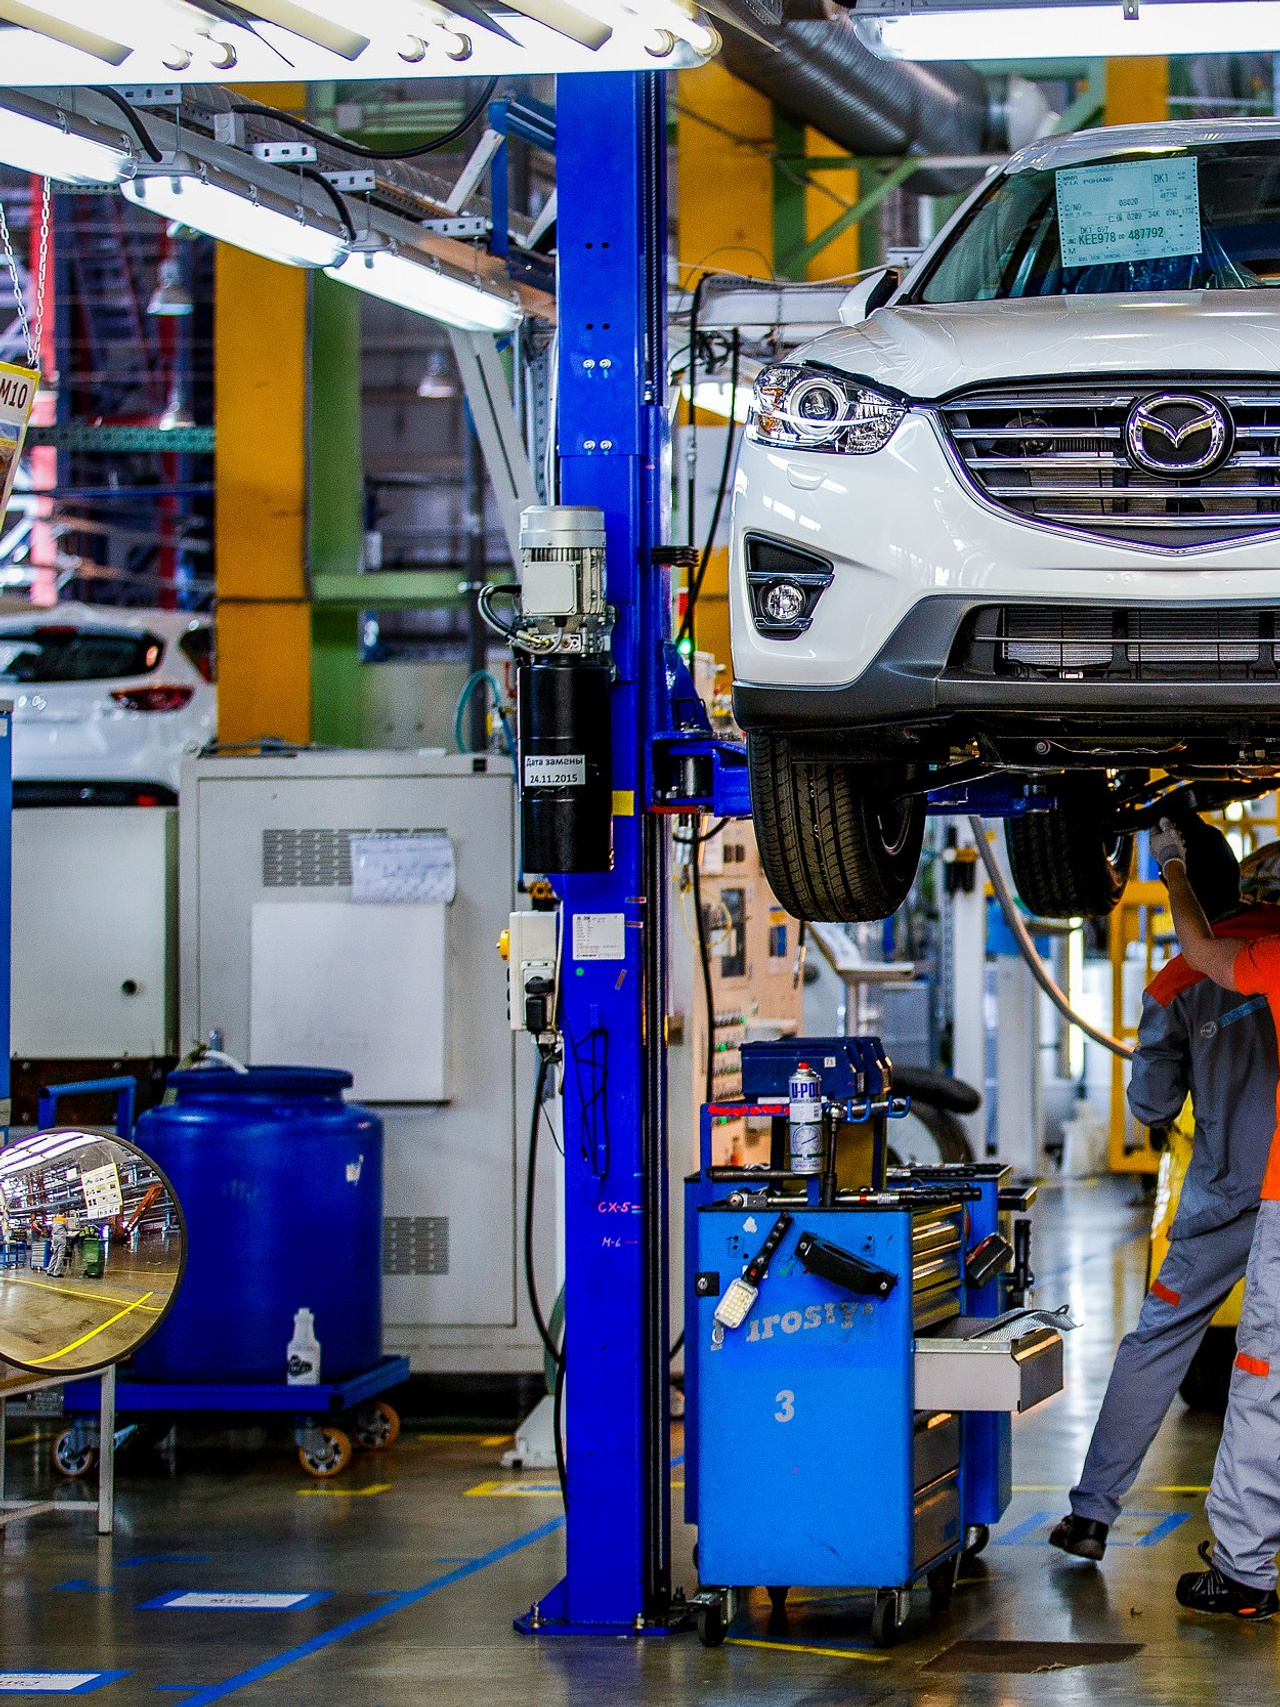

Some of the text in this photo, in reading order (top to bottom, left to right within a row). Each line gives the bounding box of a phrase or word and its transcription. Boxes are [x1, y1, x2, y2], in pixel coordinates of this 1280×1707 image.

[1153, 173, 1169, 183] DK1
[1078, 231, 1116, 245] KEE978
[1128, 226, 1164, 240] 487792
[527, 757, 583, 767] Дата замены
[530, 773, 578, 783] 24.11.2015
[598, 1201, 631, 1213] CX-5
[774, 1389, 795, 1423] 3
